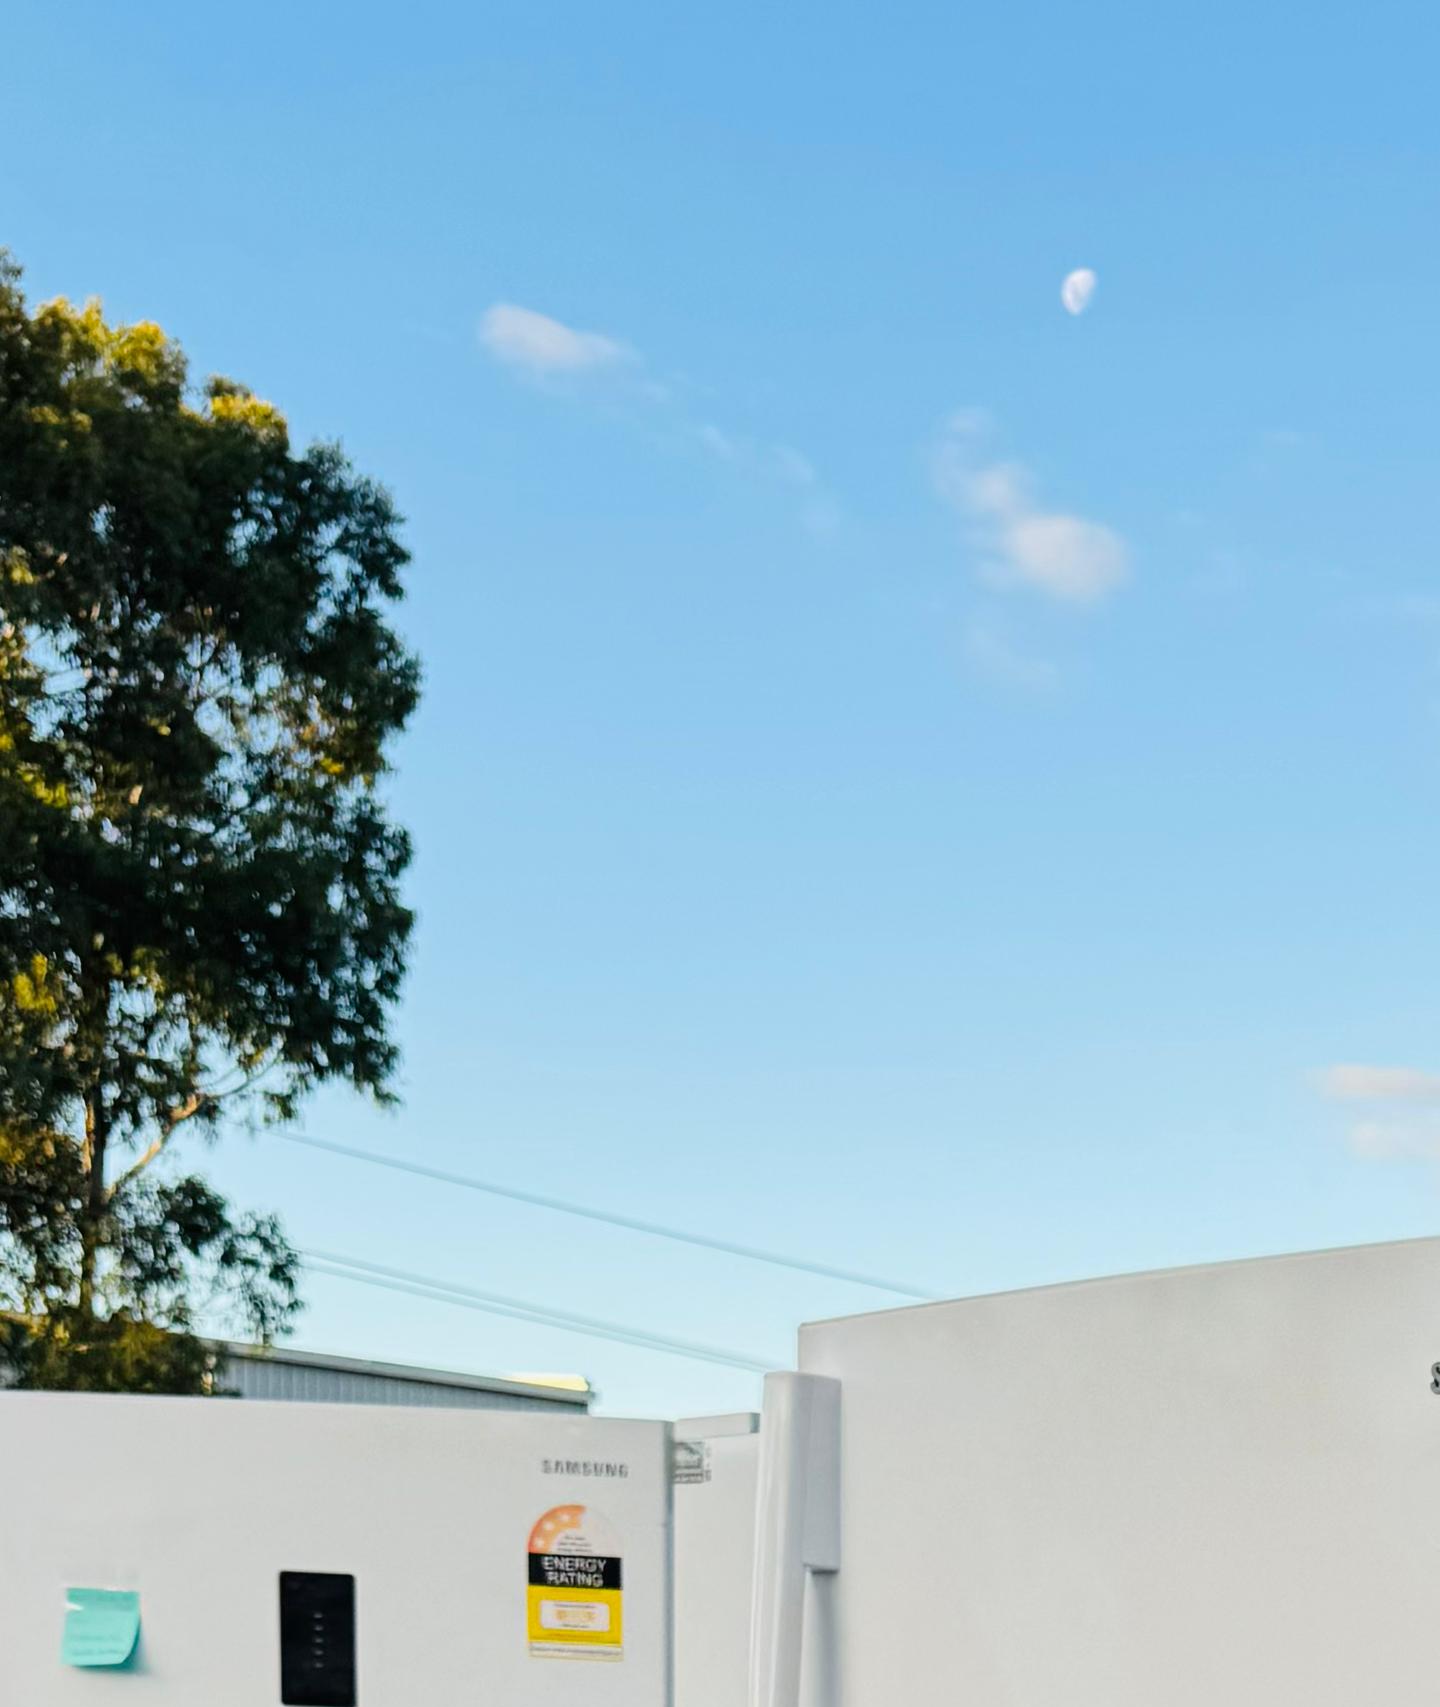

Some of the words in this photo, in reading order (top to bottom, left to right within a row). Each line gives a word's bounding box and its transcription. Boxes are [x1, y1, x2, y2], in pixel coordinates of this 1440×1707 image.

[541, 1459, 629, 1478] SAMSUNG
[543, 1556, 607, 1573] ENERGY
[545, 1571, 604, 1587] RATING
